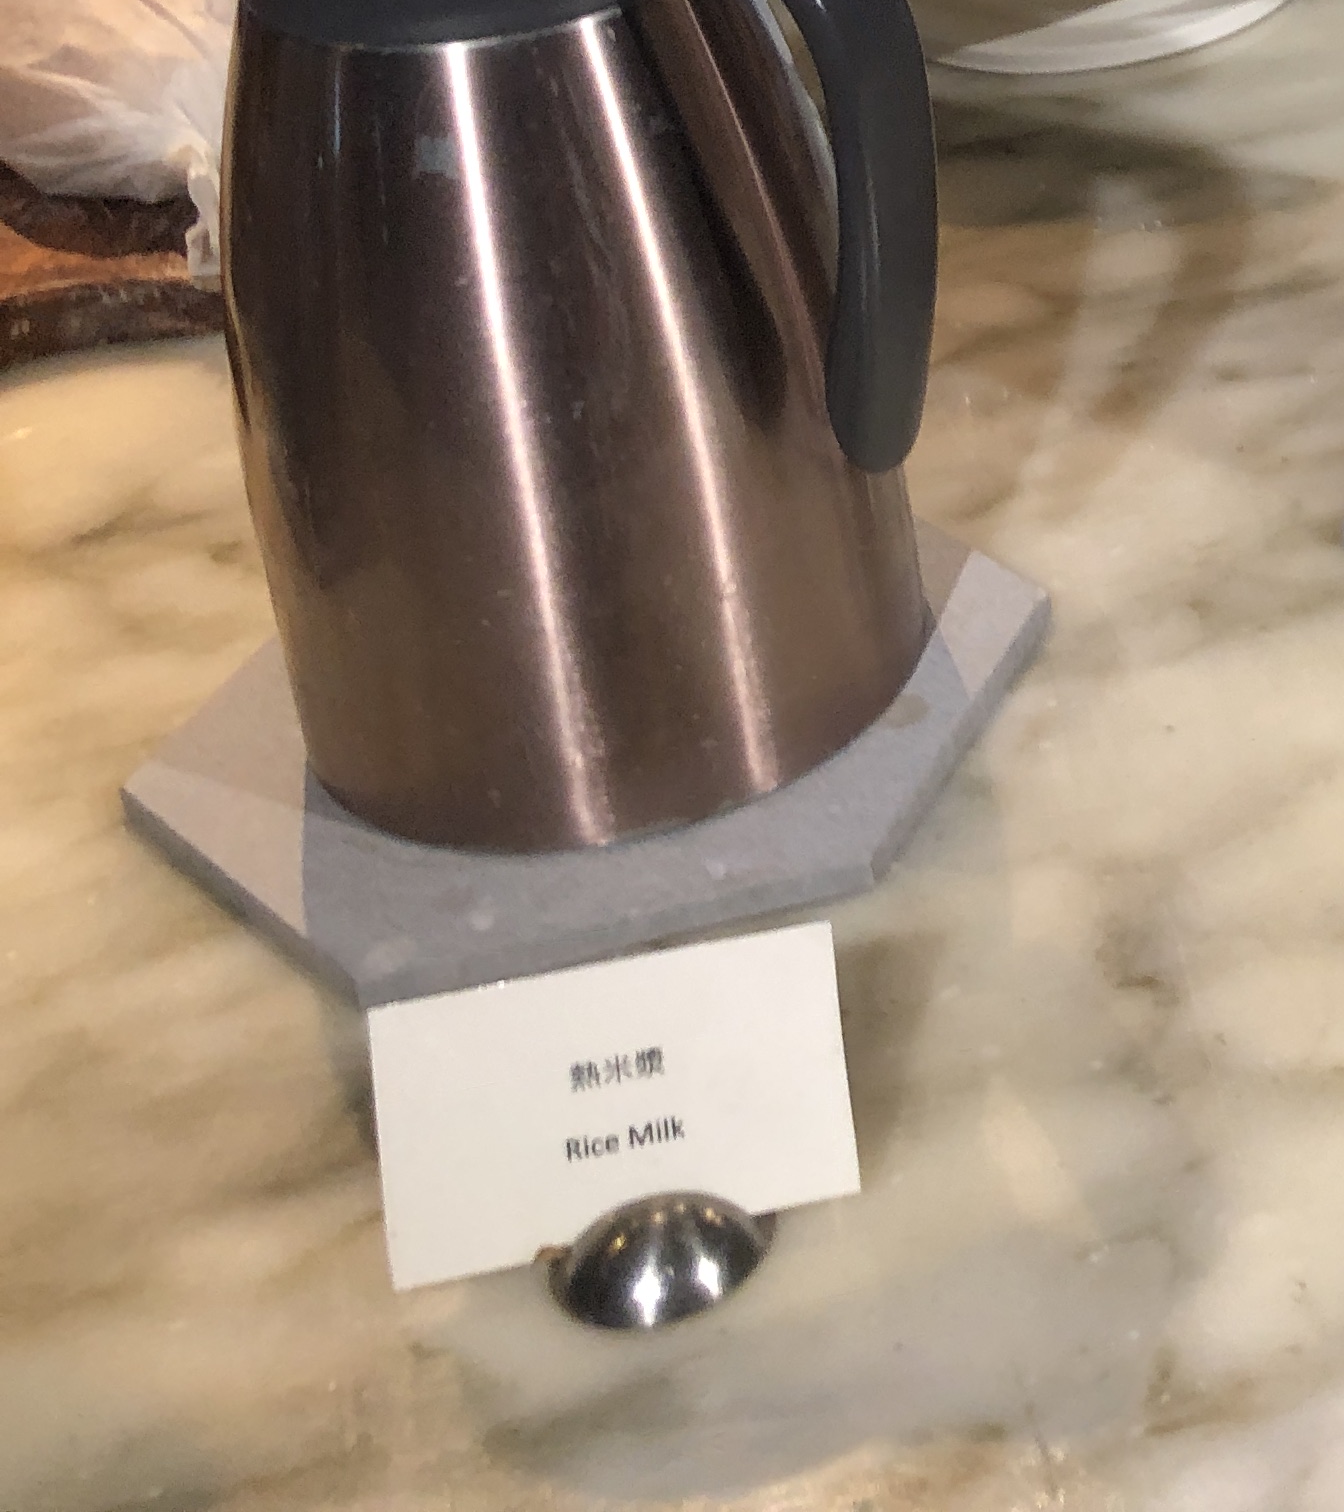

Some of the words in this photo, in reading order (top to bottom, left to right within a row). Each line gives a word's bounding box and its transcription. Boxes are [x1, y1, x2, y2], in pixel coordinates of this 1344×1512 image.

[569, 1046, 665, 1093] 熱米漿
[565, 1134, 620, 1163] Rice
[628, 1115, 686, 1149] Milk
